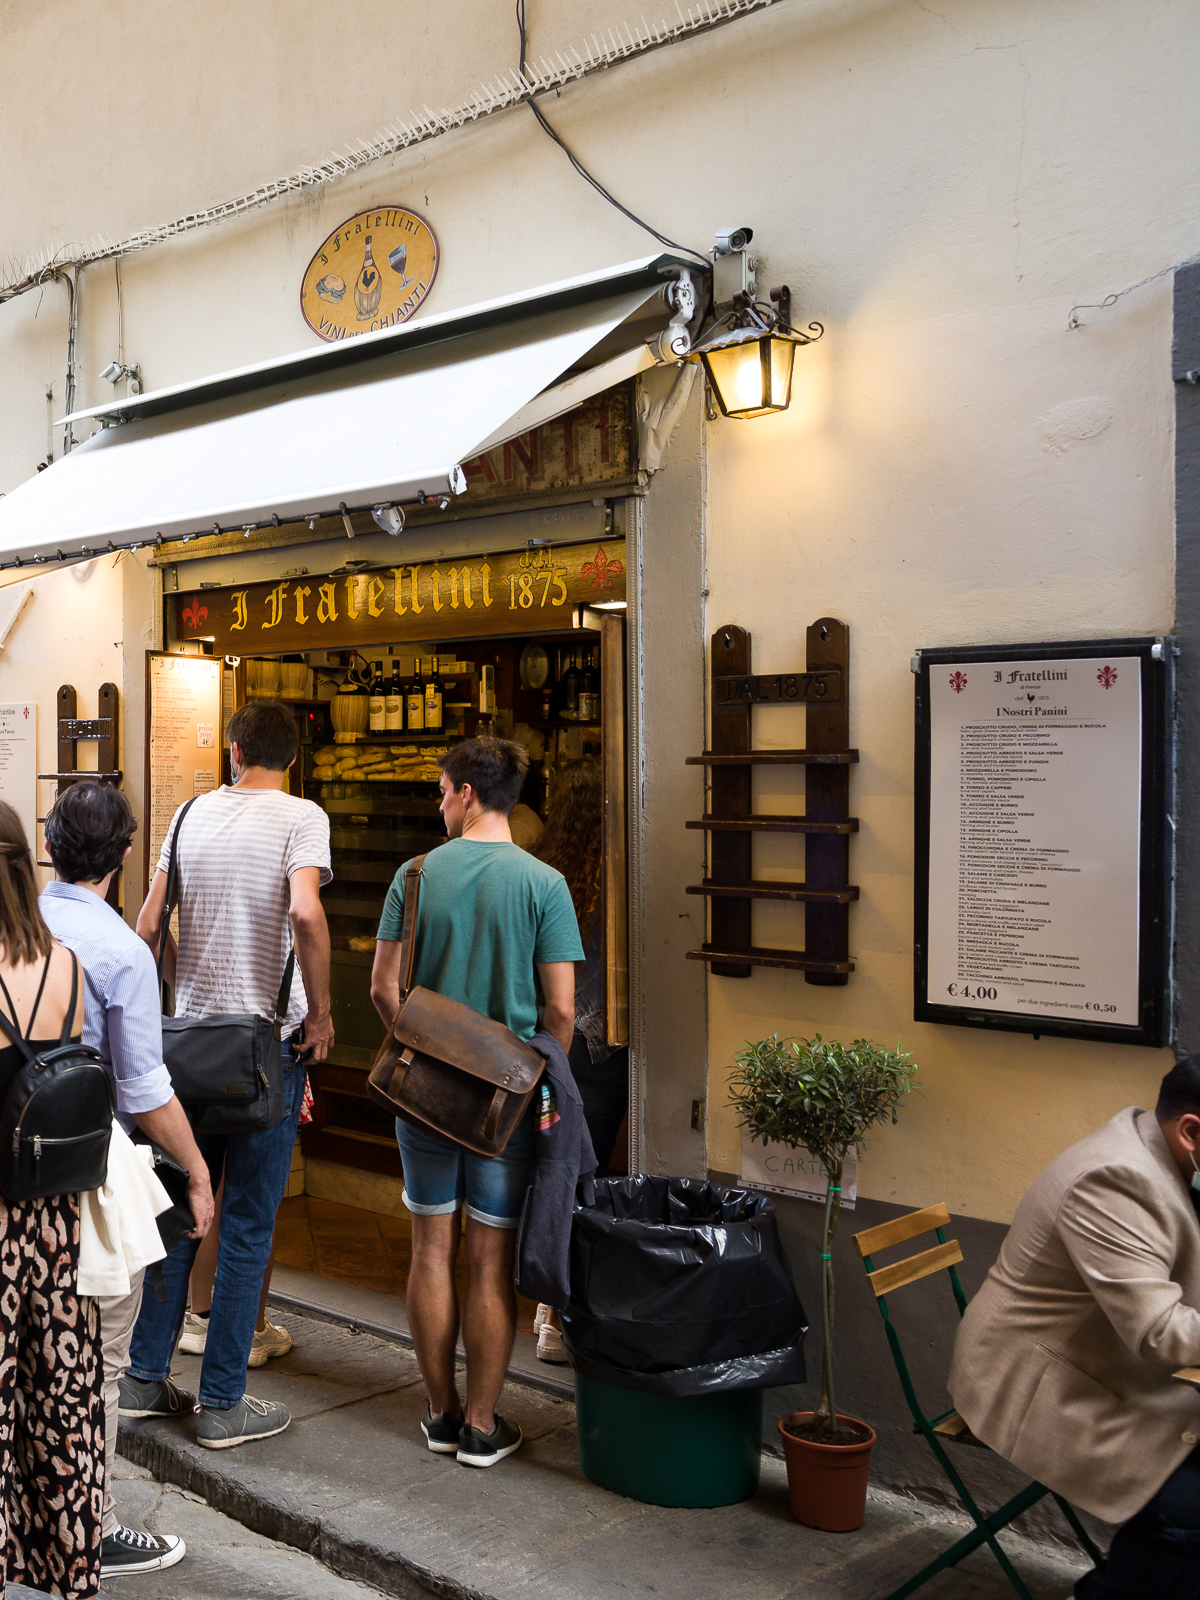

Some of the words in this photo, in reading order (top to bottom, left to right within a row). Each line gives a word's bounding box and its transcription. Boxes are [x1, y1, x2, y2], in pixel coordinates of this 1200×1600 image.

[318, 250, 329, 266] I
[333, 209, 422, 253] Fratellini
[319, 316, 348, 340] VINI
[370, 281, 428, 333] CHIANTI
[519, 547, 554, 569] dal
[229, 590, 249, 632] I
[261, 554, 494, 630] Fratellini
[507, 568, 568, 610] 1875
[726, 677, 768, 702] DAL
[773, 675, 828, 700] 1875
[993, 671, 1002, 683] I
[1006, 669, 1068, 685] Fratellini
[996, 707, 1002, 716] I
[1002, 707, 1033, 716] Nostri
[1035, 706, 1068, 716] Panini
[946, 982, 958, 997] €
[960, 985, 998, 1001] 4,00
[1039, 999, 1068, 1009] ingredienti
[1084, 1002, 1092, 1010] €
[1093, 1002, 1117, 1013] 0,50
